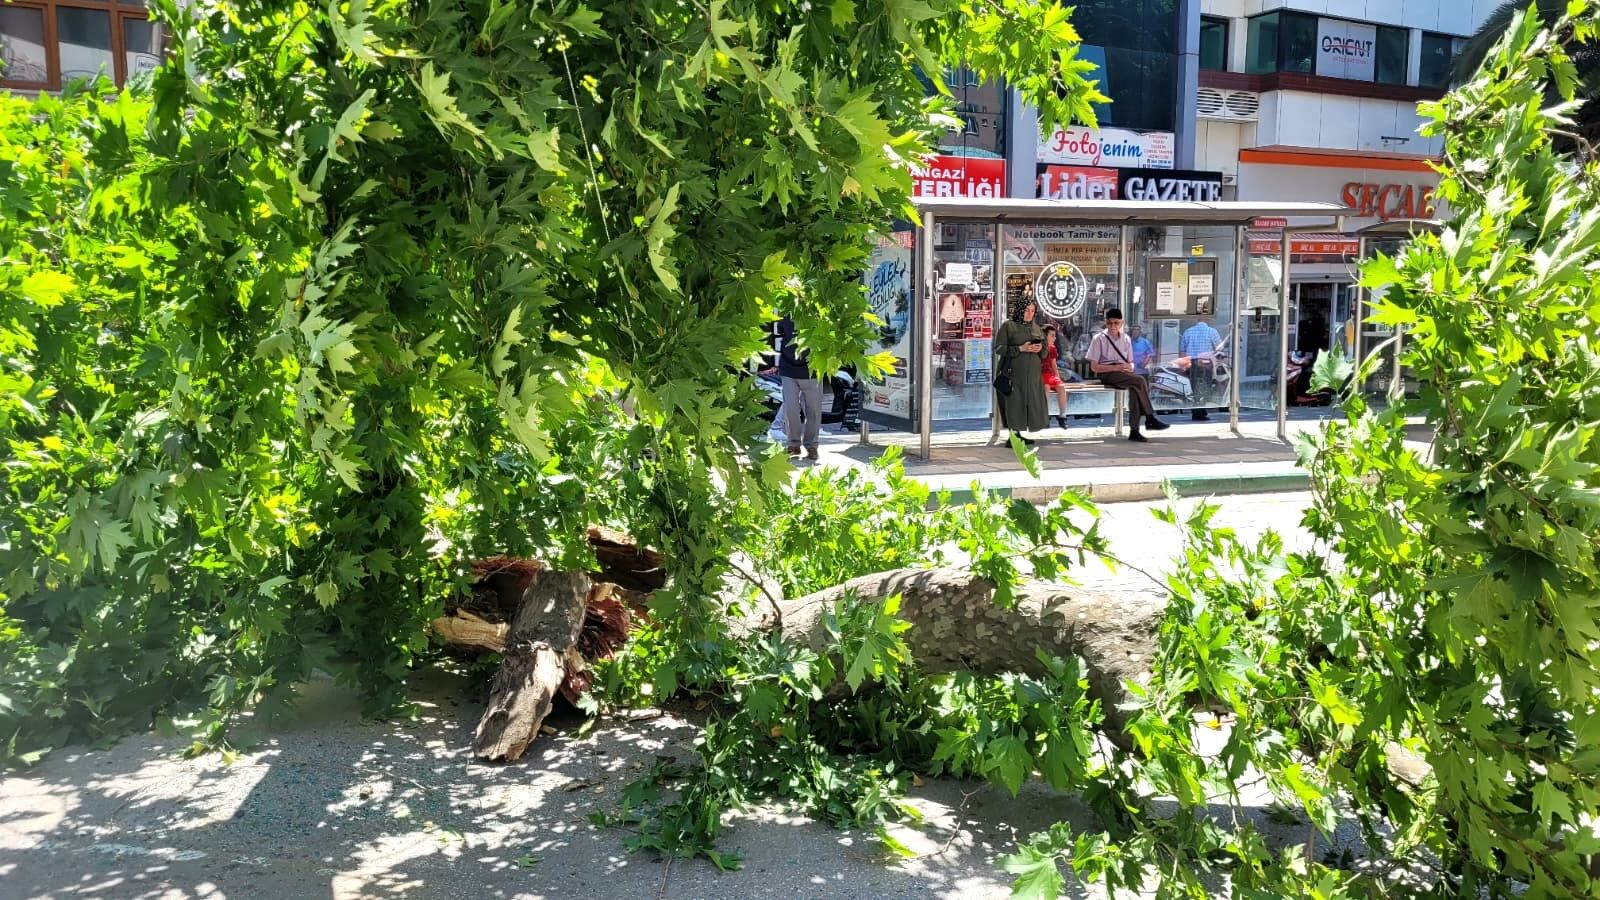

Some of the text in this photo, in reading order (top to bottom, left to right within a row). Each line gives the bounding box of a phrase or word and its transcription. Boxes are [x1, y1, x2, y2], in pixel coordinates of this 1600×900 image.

[1322, 36, 1372, 57] ORIENT
[1053, 131, 1142, 166] Fotojenim
[1039, 173, 1115, 200] Lider
[1124, 177, 1222, 201] GAZETE
[1015, 230, 1064, 239] Notebook
[1068, 230, 1094, 239] Tamir
